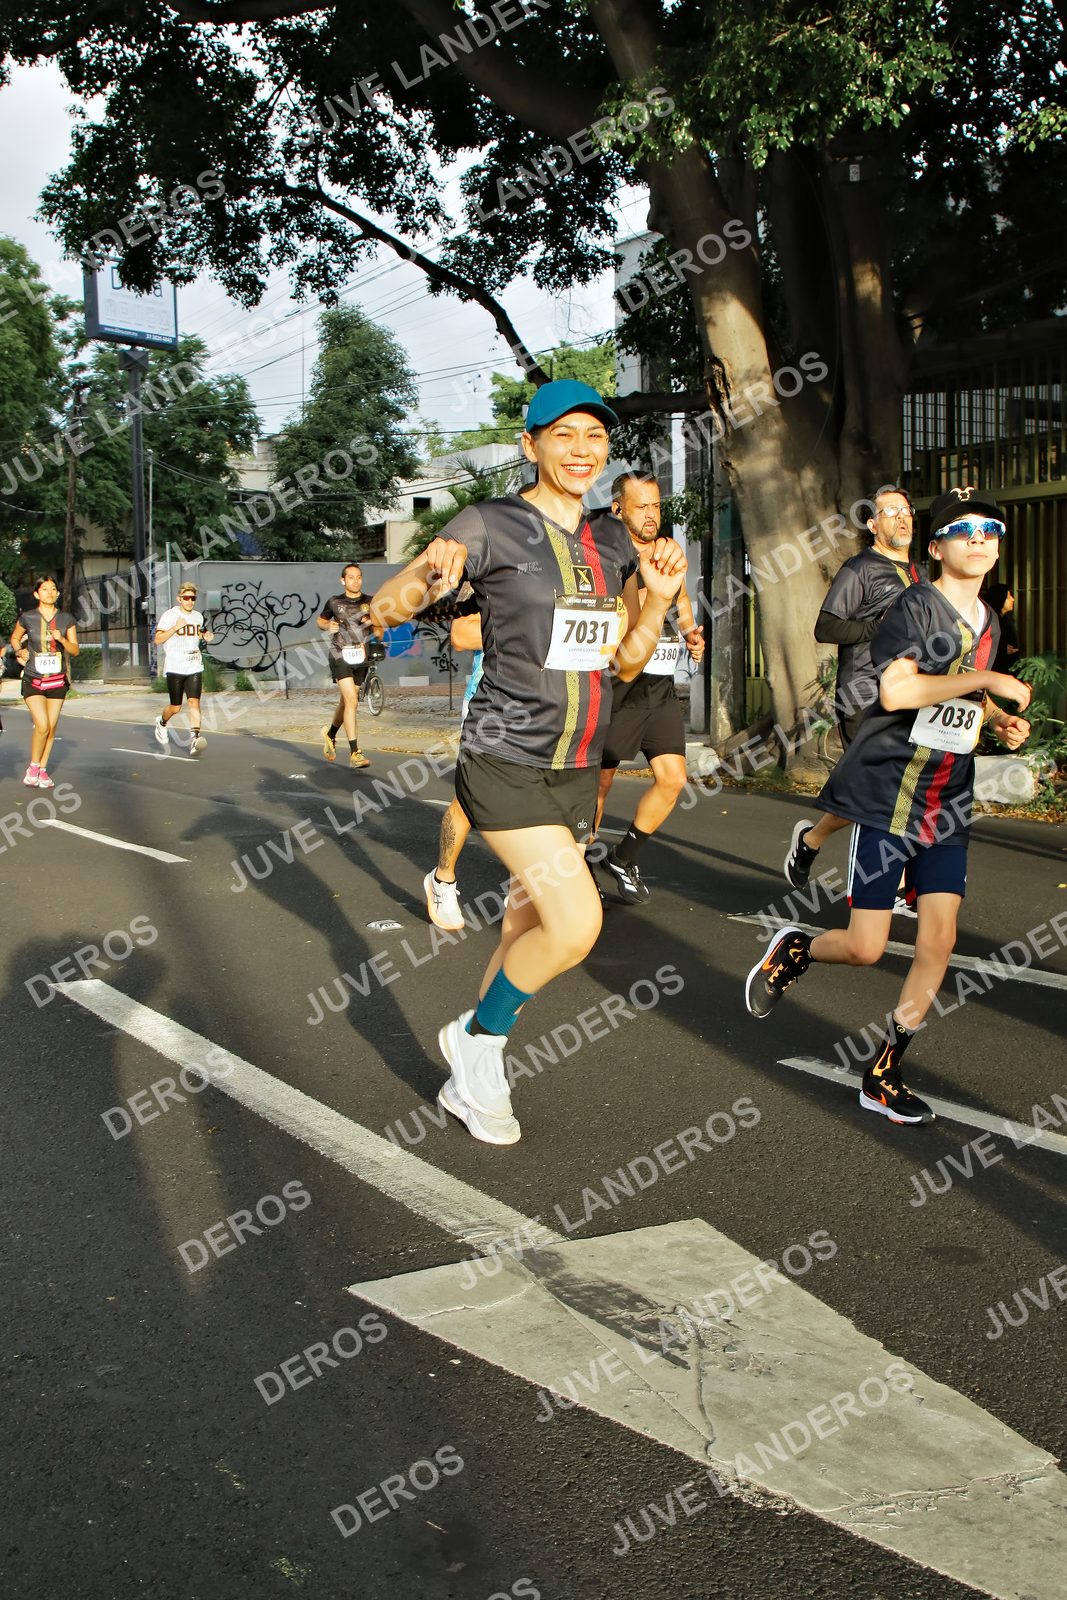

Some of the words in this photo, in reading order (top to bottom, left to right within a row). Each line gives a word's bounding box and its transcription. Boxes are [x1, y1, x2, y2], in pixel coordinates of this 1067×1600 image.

[221, 580, 263, 596] TOY
[563, 619, 609, 644] 7031
[928, 704, 976, 730] 7038
